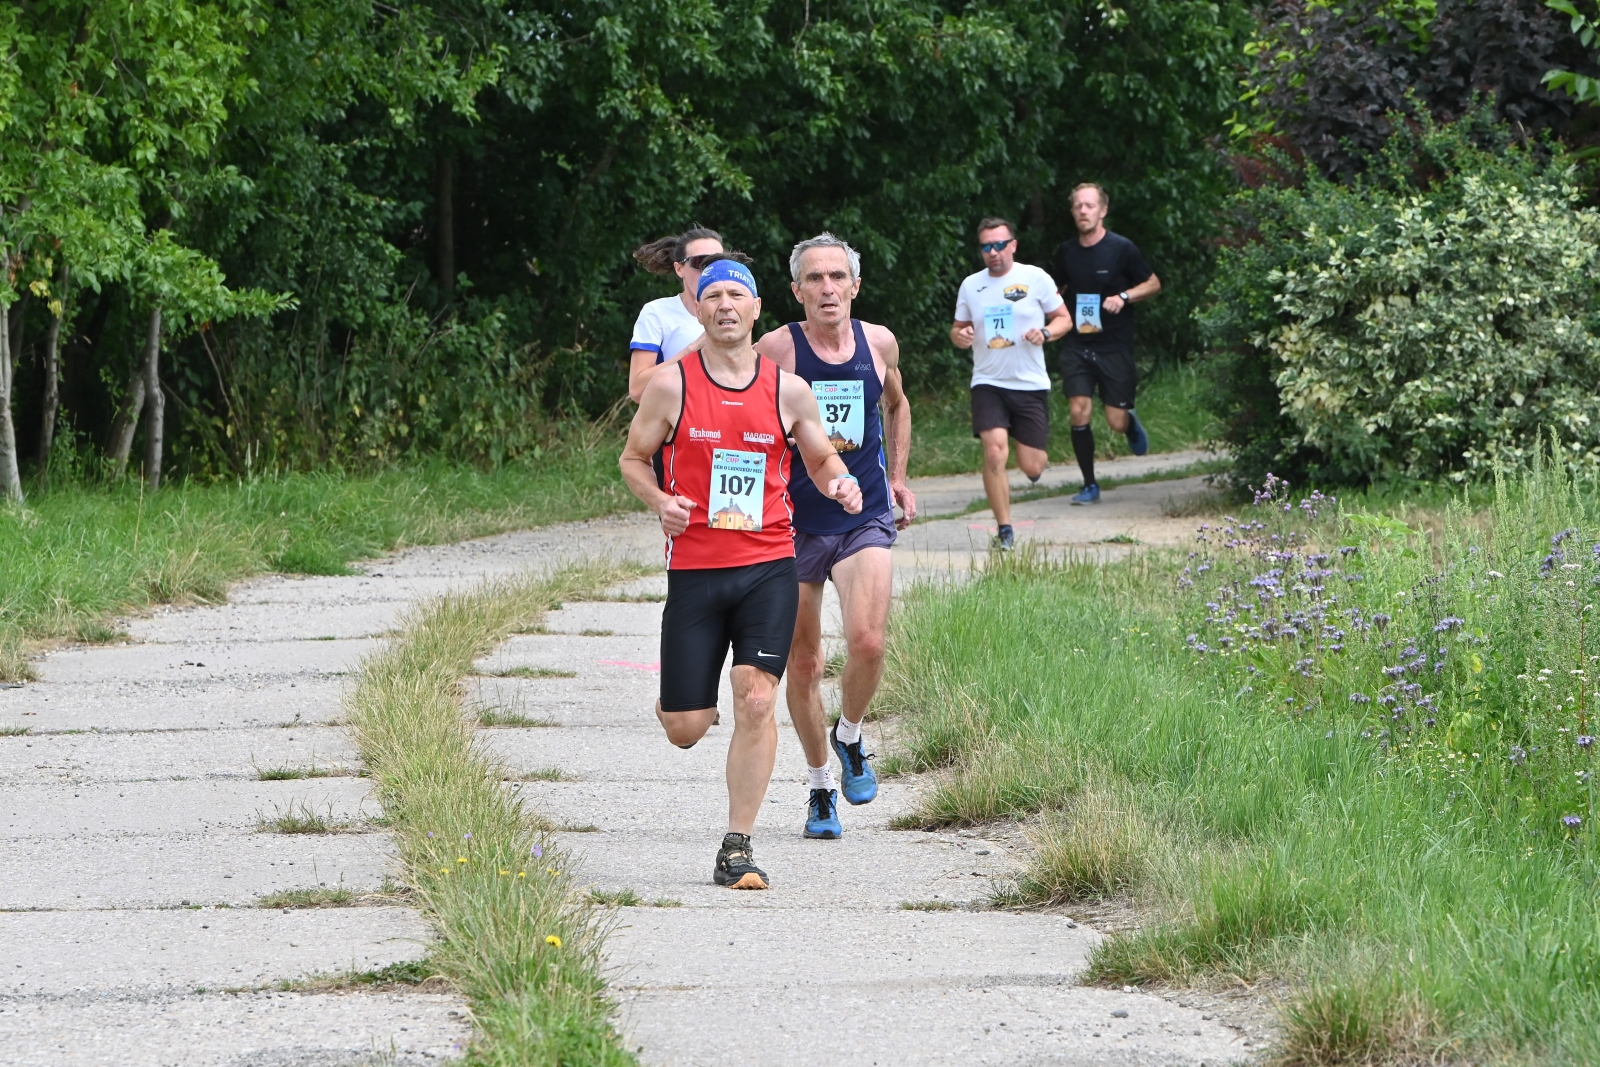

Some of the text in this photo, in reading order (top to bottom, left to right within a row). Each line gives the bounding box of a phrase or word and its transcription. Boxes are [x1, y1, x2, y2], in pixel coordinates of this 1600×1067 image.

[1082, 306, 1094, 317] 66
[993, 318, 1005, 329] 71
[826, 403, 851, 423] 37
[689, 427, 721, 439] Krakonoš
[743, 431, 774, 441] MARATON
[720, 474, 756, 496] 107
